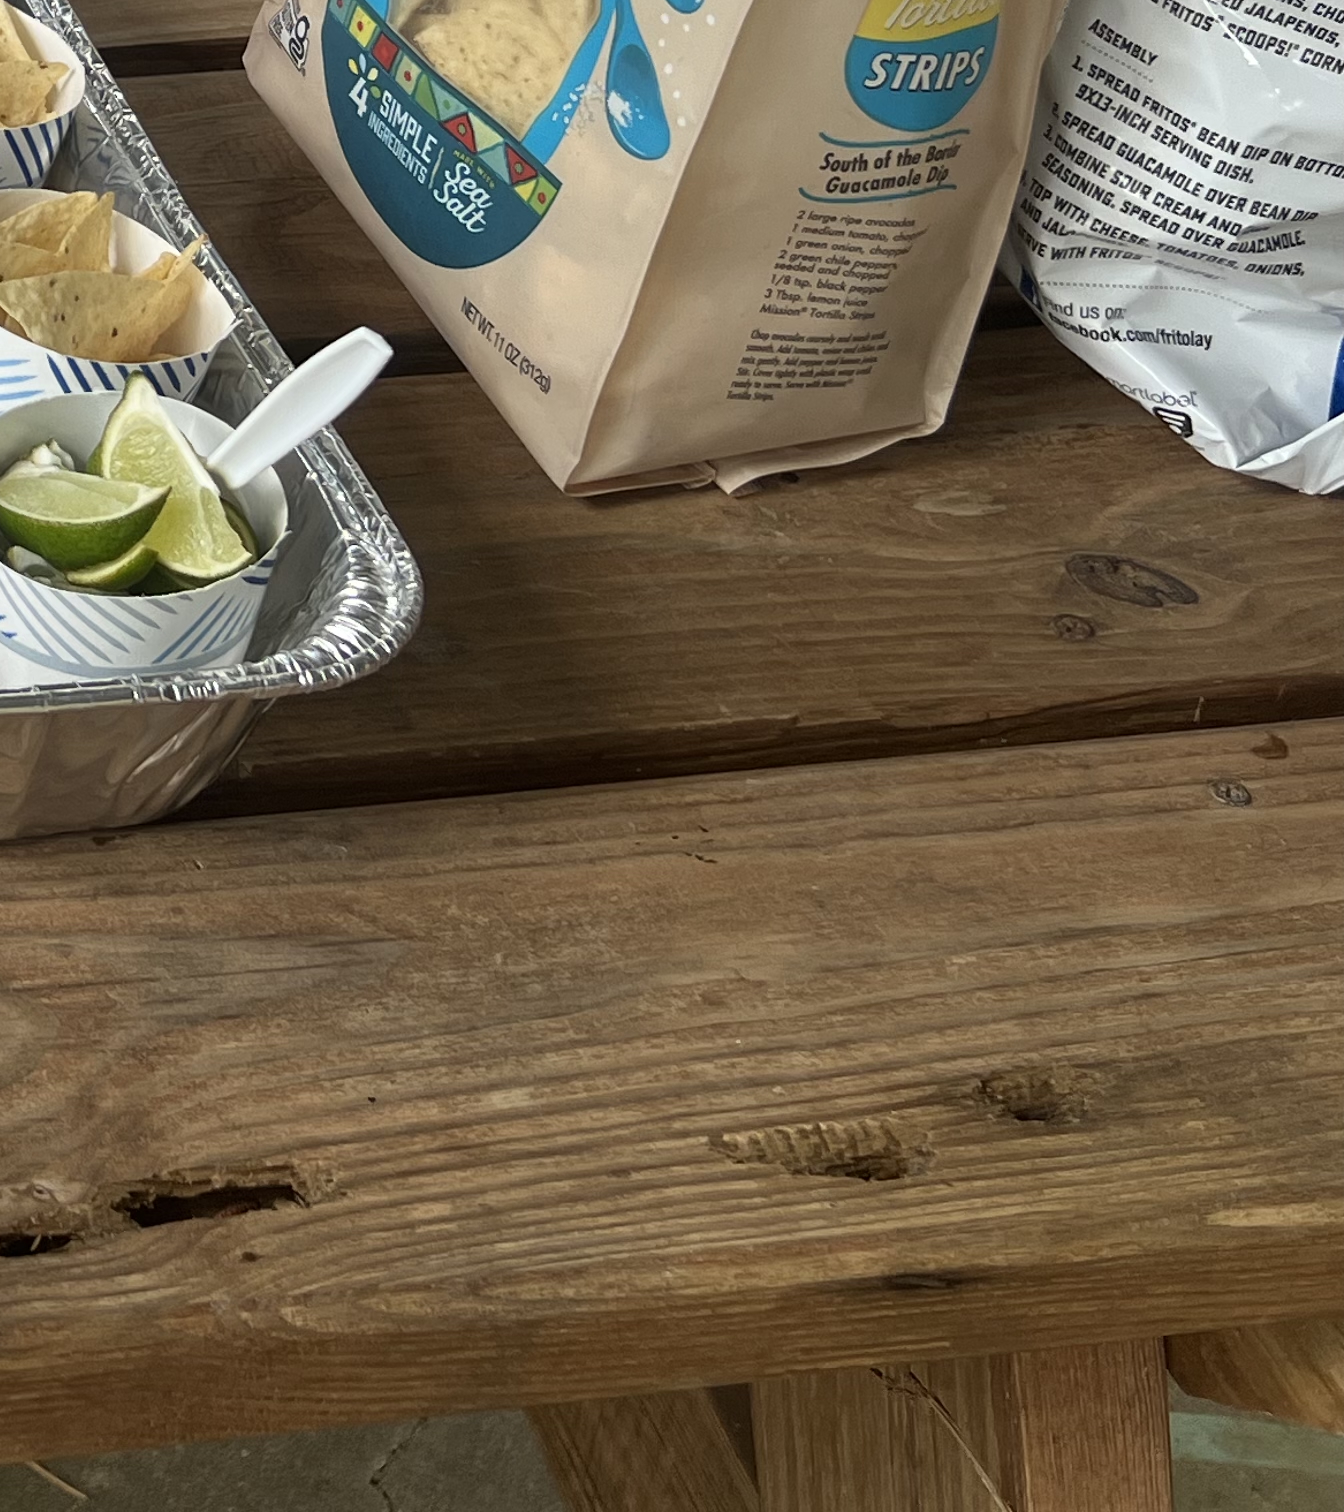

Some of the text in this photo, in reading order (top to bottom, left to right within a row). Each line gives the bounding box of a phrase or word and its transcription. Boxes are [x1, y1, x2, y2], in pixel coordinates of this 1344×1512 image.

[1088, 19, 1158, 66] ASSEMBLY
[864, 47, 985, 92] STRIPS
[348, 76, 438, 164] 4 SIMPLE
[1087, 64, 1140, 102] SPREAD
[1197, 127, 1240, 155] BEAN
[1241, 145, 1270, 162] DIP
[1269, 150, 1294, 167] ON
[1294, 156, 1344, 180] BOTTO
[368, 110, 428, 185] INGREDIENTS
[819, 152, 869, 172] South
[874, 149, 892, 170] of
[896, 148, 921, 167] the
[1062, 111, 1117, 150] SPREAD
[1116, 142, 1205, 197] GUACAMOLE
[1205, 188, 1248, 212] OVER
[1249, 200, 1293, 221] BEAN
[1150, 125, 1213, 169] SERVING
[1213, 159, 1254, 184] DISH.
[445, 162, 493, 209] Sea
[825, 164, 949, 194] Guacamole Dip
[1028, 177, 1052, 202] TOP
[1054, 195, 1090, 226] WITH
[1042, 152, 1115, 209] SEASONING.
[1119, 201, 1180, 235] SPREAD
[1181, 227, 1225, 249] OVER
[1054, 135, 1110, 179] COMBINE
[1152, 191, 1207, 223] CREAM
[1206, 215, 1243, 237] AND
[433, 181, 487, 233] Salt
[807, 211, 837, 224] large
[460, 296, 480, 325] NET
[493, 332, 505, 353] 11
[504, 342, 521, 367] OZ
[1080, 306, 1100, 319] us
